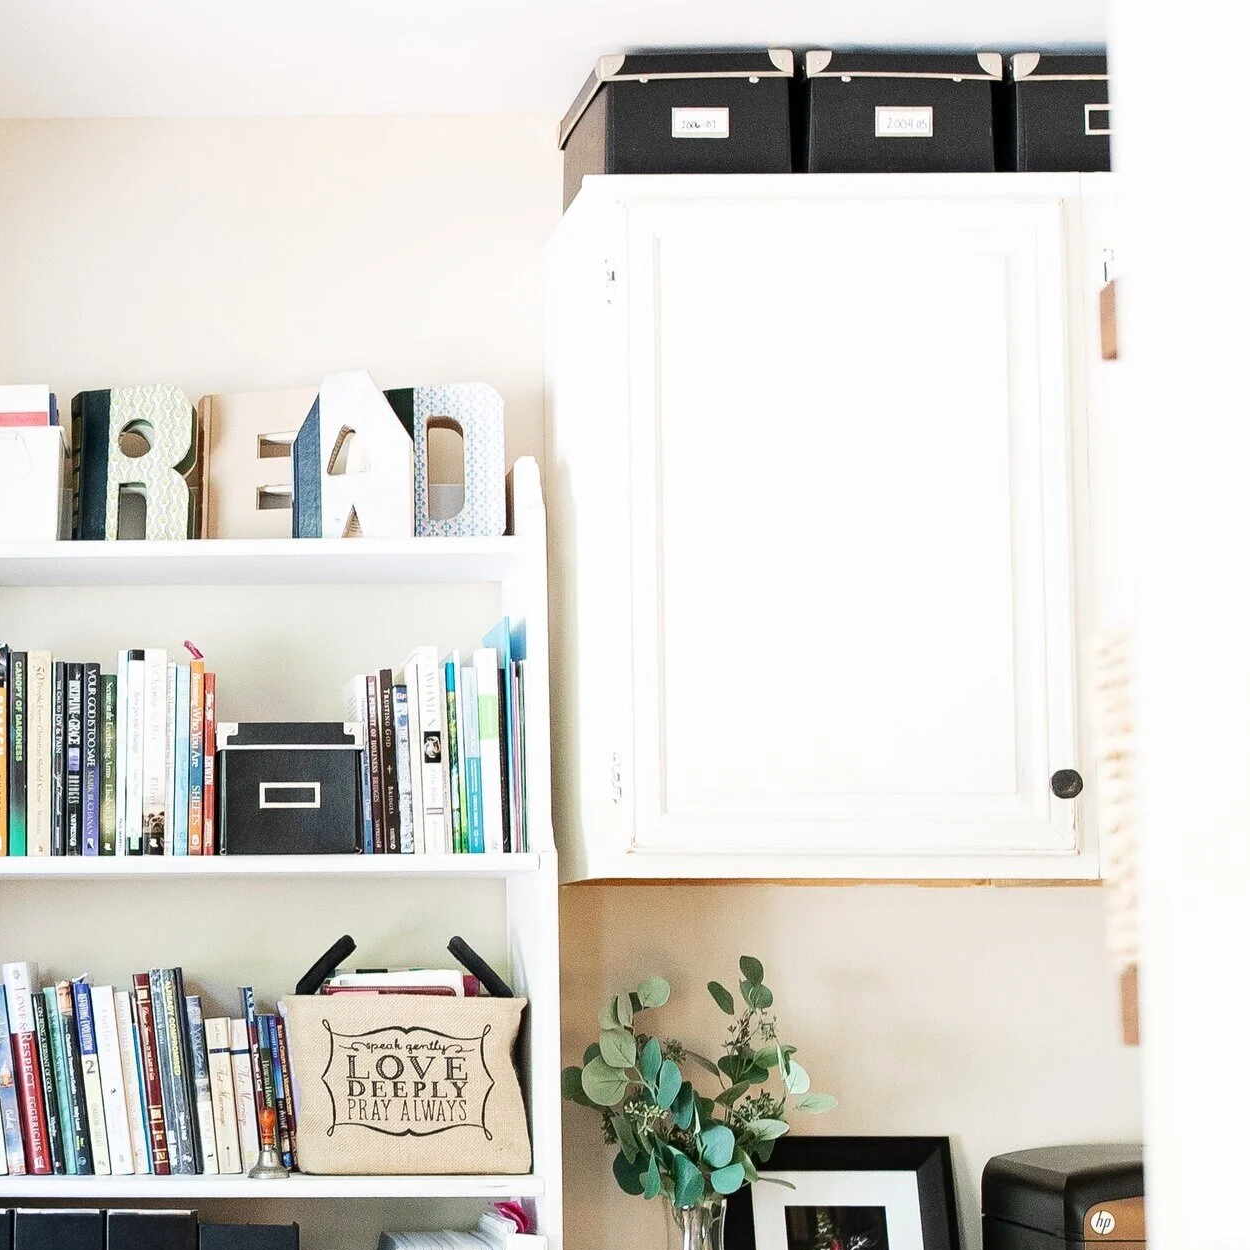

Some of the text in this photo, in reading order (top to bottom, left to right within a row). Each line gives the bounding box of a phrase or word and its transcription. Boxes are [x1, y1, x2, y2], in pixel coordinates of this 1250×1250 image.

[70, 370, 507, 541] READ
[105, 681, 114, 704] Secure
[15, 661, 23, 762] CANOPY OF DARKNESS
[191, 707, 202, 731] Who
[369, 698, 377, 727] PURSUIT
[383, 688, 391, 727] TRUSTING
[54, 714, 63, 728] JOY
[55, 728, 62, 736] &
[68, 720, 81, 745] GRACE
[371, 728, 377, 739] OF
[33, 665, 46, 803] 50 People Every Christian Should Know
[103, 722, 114, 759] Everlasting
[191, 731, 202, 750] You
[86, 669, 97, 835] YOUR GOD IS TOO SAFE MARK BUCHANAN
[191, 750, 201, 768] Are
[371, 740, 379, 774] HOLINESS
[105, 759, 113, 778] Arms
[204, 756, 214, 786] ERWIN
[68, 775, 80, 804] BRIDGES
[191, 785, 201, 826] SHEETS
[246, 990, 254, 1007] A.W.
[37, 1006, 43, 1017] ON
[77, 993, 96, 1075] REFUTING EVOLUTION 2
[165, 980, 181, 1076] ALREADY COMPROMISED
[194, 1027, 204, 1048] YOU
[42, 1042, 51, 1068] SERVANT
[365, 1039, 447, 1055] speak gently
[14, 987, 26, 1021] LOVE
[21, 1032, 35, 1090] RESPECT
[29, 1096, 42, 1152] EGGERICHS
[45, 1068, 51, 1077] OF
[261, 1060, 270, 1074] HOW
[345, 1054, 469, 1081] LOVE
[45, 1077, 53, 1092] GOD
[347, 1080, 469, 1099] DEEPLY
[218, 1091, 230, 1127] Marriage
[239, 1092, 252, 1127] Marriage
[347, 1099, 467, 1122] PRAY ALWAYS
[1095, 1210, 1112, 1235] hp
